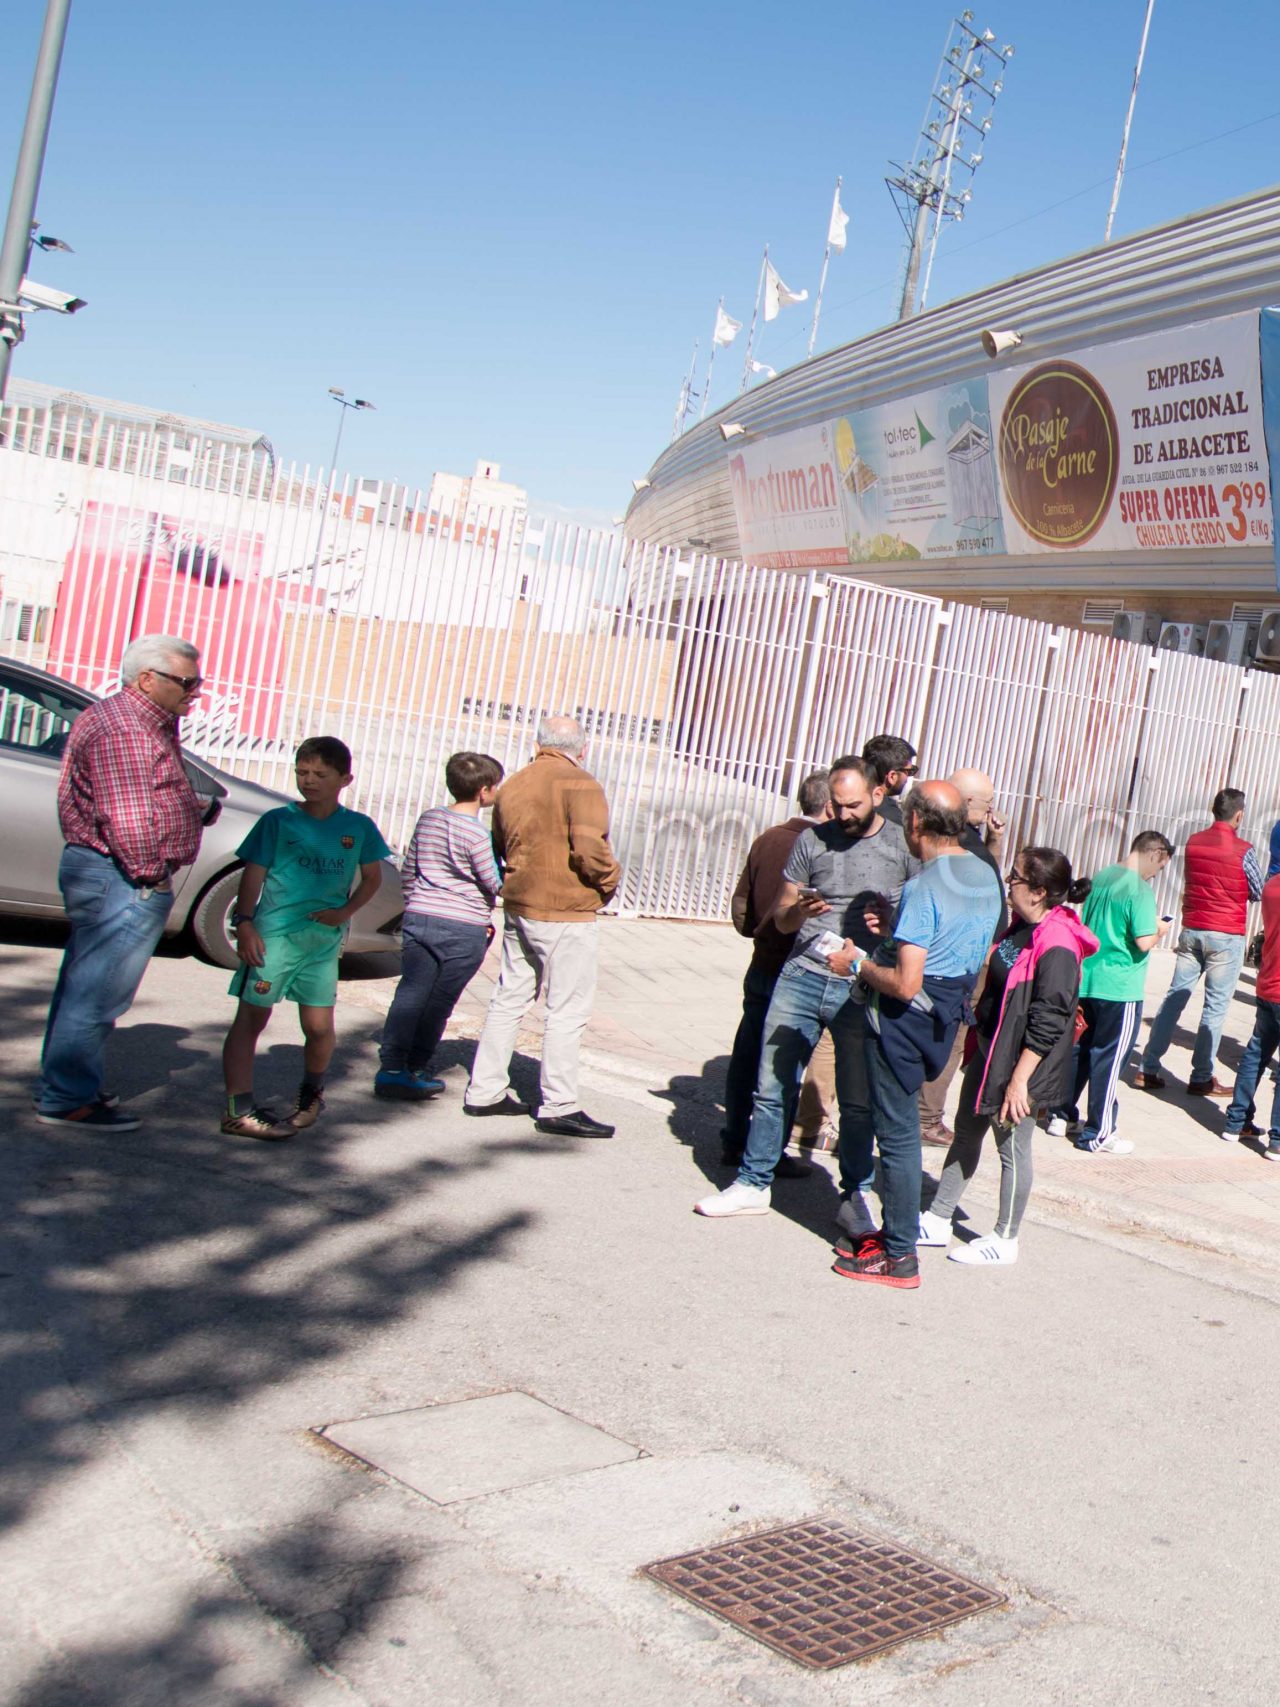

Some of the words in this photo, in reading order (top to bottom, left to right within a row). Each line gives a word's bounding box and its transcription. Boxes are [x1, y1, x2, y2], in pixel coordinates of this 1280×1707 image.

[1147, 356, 1224, 391] EMPRESA
[1131, 391, 1249, 430] TRADICIONAL
[1012, 407, 1069, 465] Pasaje
[1133, 443, 1154, 465] DE
[1157, 430, 1251, 462] ALBACETE
[1043, 445, 1096, 488] Carne
[1216, 463, 1229, 475] 967
[1244, 460, 1260, 473] 184
[1120, 489, 1162, 524] SUPER
[1164, 484, 1220, 521] OFERTA
[1136, 523, 1175, 547] CHULETA
[1175, 523, 1191, 546] DE
[1191, 520, 1226, 546] CERDO
